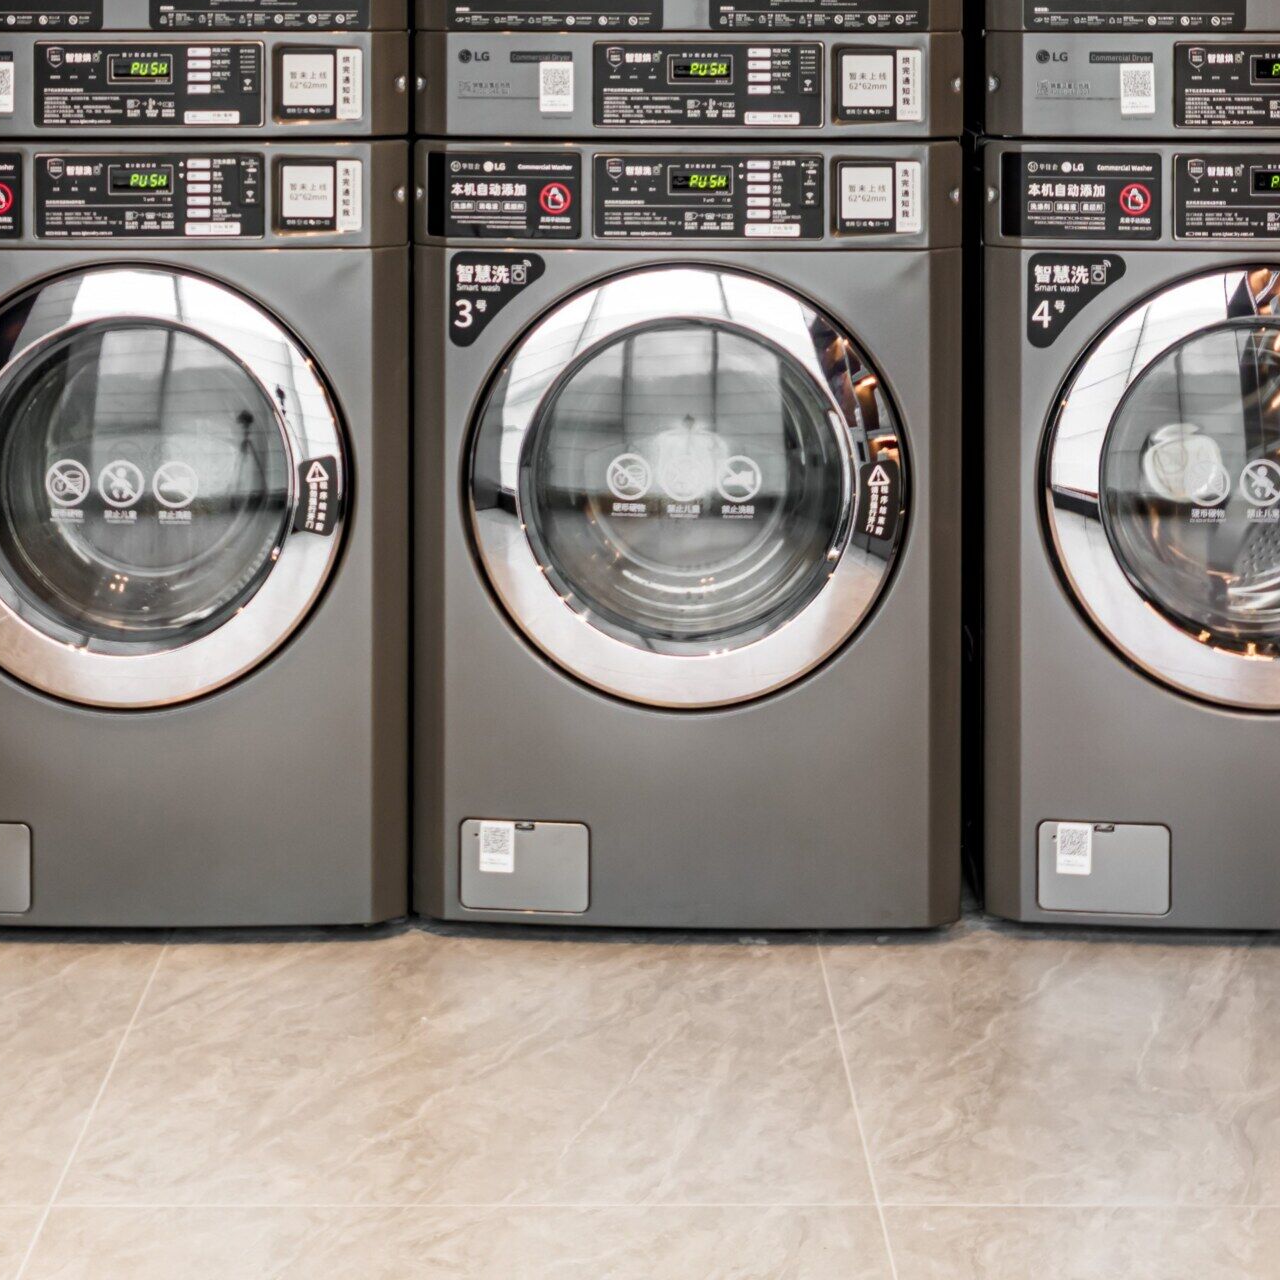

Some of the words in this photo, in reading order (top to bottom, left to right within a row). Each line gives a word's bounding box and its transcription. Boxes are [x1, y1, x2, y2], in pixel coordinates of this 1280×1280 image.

[511, 52, 551, 61] Commercial
[1090, 53, 1130, 62] Commercial
[131, 62, 168, 76] PUSH
[690, 62, 727, 76] PUSH
[289, 71, 327, 79] 暂未上线
[849, 72, 887, 80] 暂未上线
[130, 173, 167, 187] PUSH
[689, 174, 727, 187] PUSH
[289, 183, 327, 191] 暂未上线
[451, 183, 527, 197] 本机自动添加
[848, 184, 886, 193] 暂未上线
[1028, 184, 1105, 197] 本机自动添加
[456, 264, 510, 284] 智慧洗
[1034, 264, 1089, 285] 智慧洗
[457, 283, 479, 292] Smart
[481, 283, 500, 292] wash
[1034, 284, 1058, 292] Smart
[1060, 284, 1080, 293] wash
